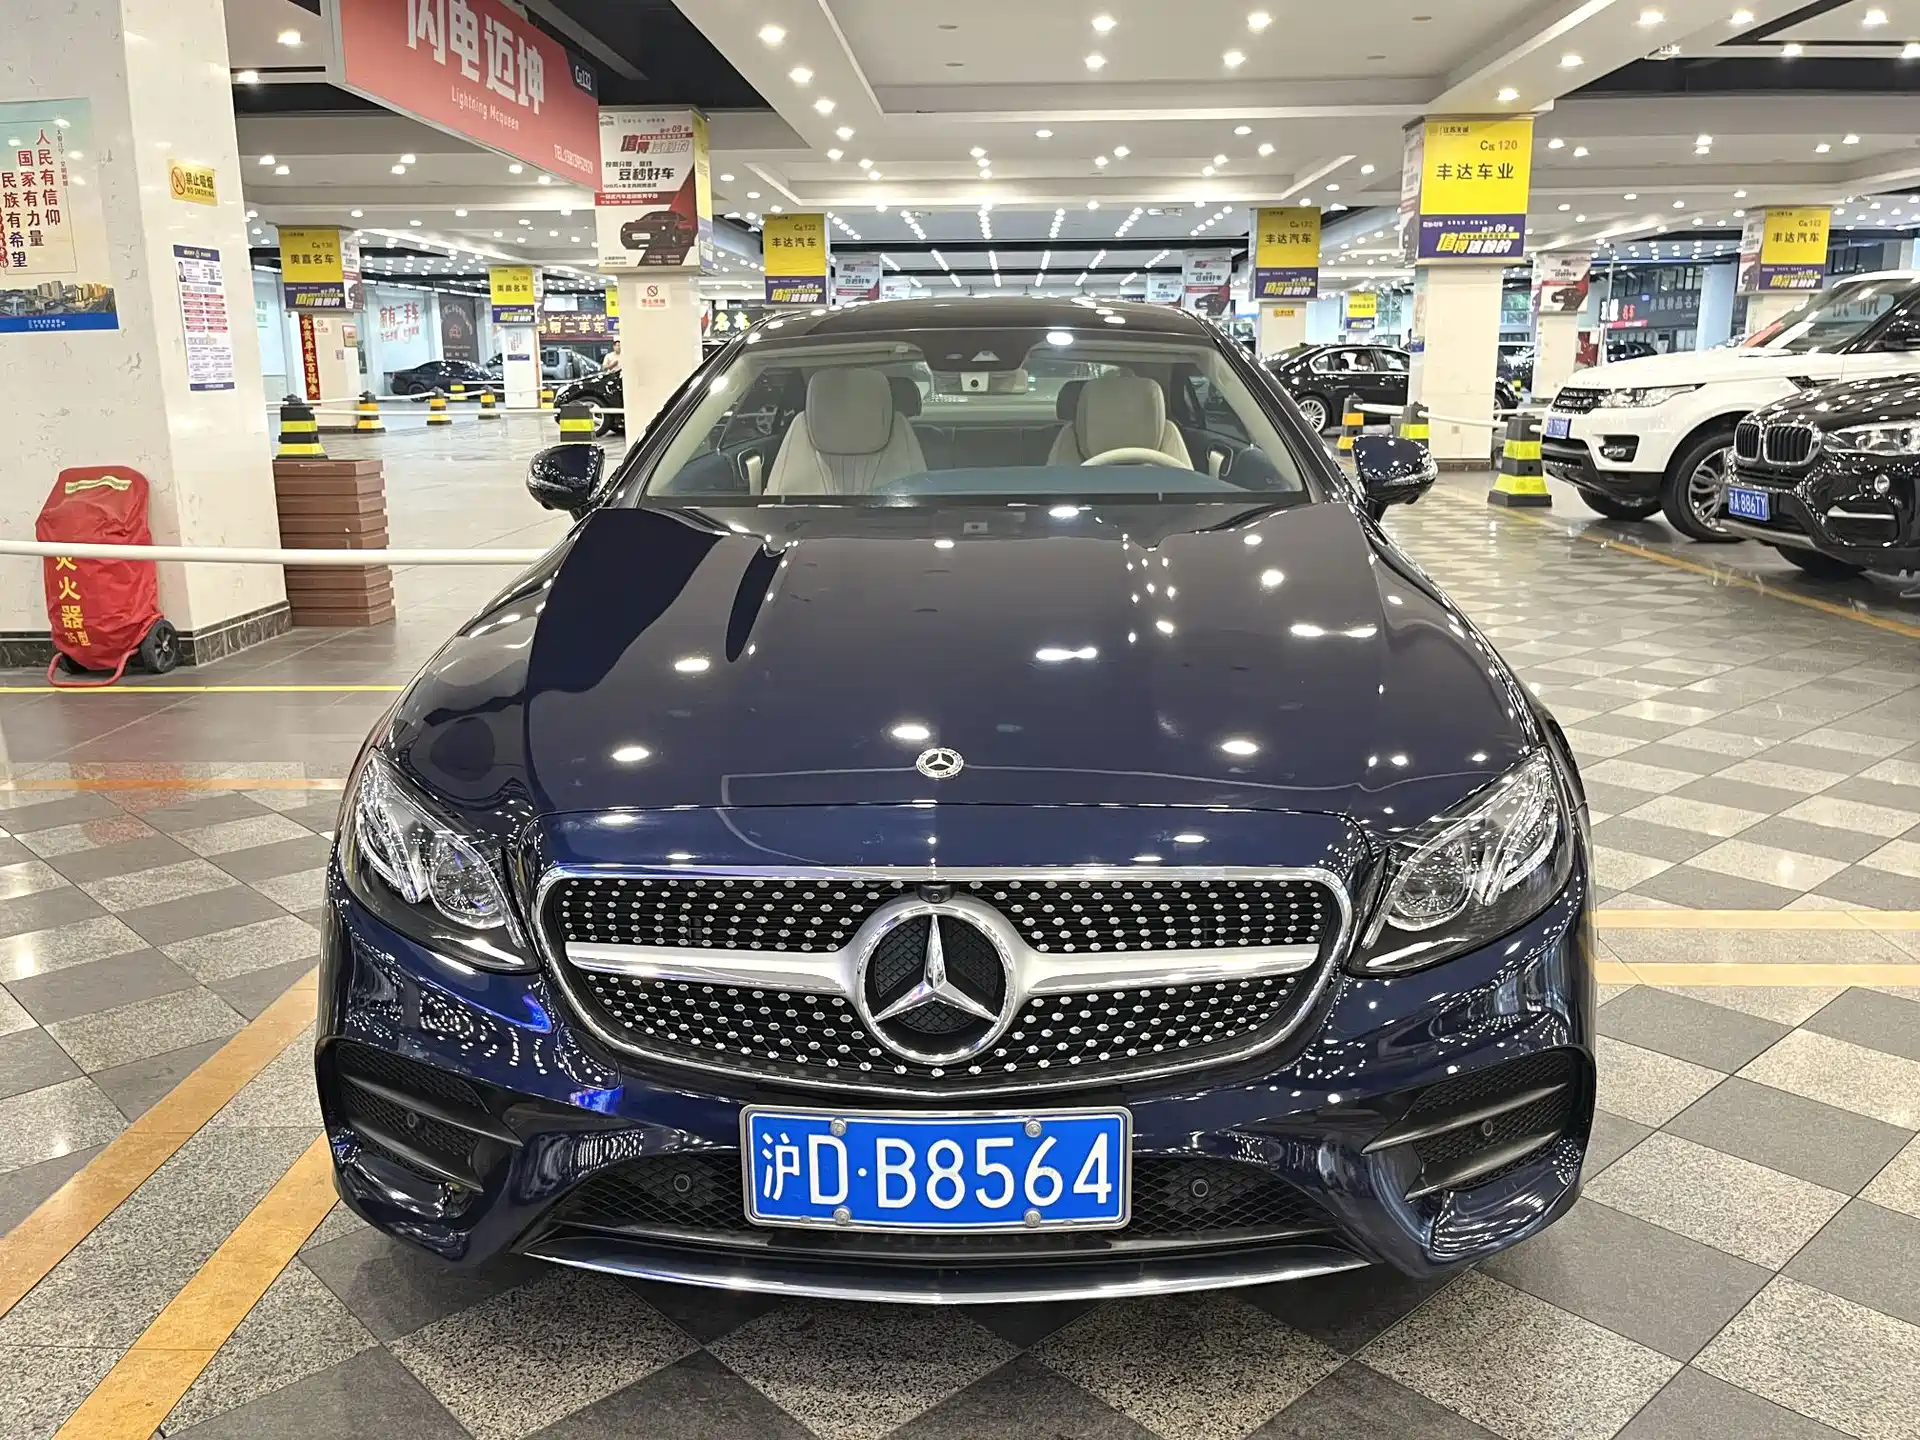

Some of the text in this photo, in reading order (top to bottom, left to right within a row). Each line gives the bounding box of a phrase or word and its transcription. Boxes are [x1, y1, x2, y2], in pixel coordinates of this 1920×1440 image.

[406, 0, 544, 115] 闪电迈坤
[451, 86, 519, 130] Lightning Mcqueen
[1498, 139, 1518, 151] 120
[36, 128, 61, 226] 人民有信仰
[1436, 162, 1514, 180] 丰达车业
[185, 172, 214, 189] 禁止吸烟
[17, 150, 44, 247] 国家有力量
[1, 172, 28, 268] 民族有希望
[1495, 223, 1507, 232] 09
[771, 237, 817, 248] 丰达汽车
[1265, 233, 1312, 244] 丰达汽车
[1772, 232, 1819, 243] 丰达汽车
[761, 1132, 1112, 1210] 沪D·B8564
